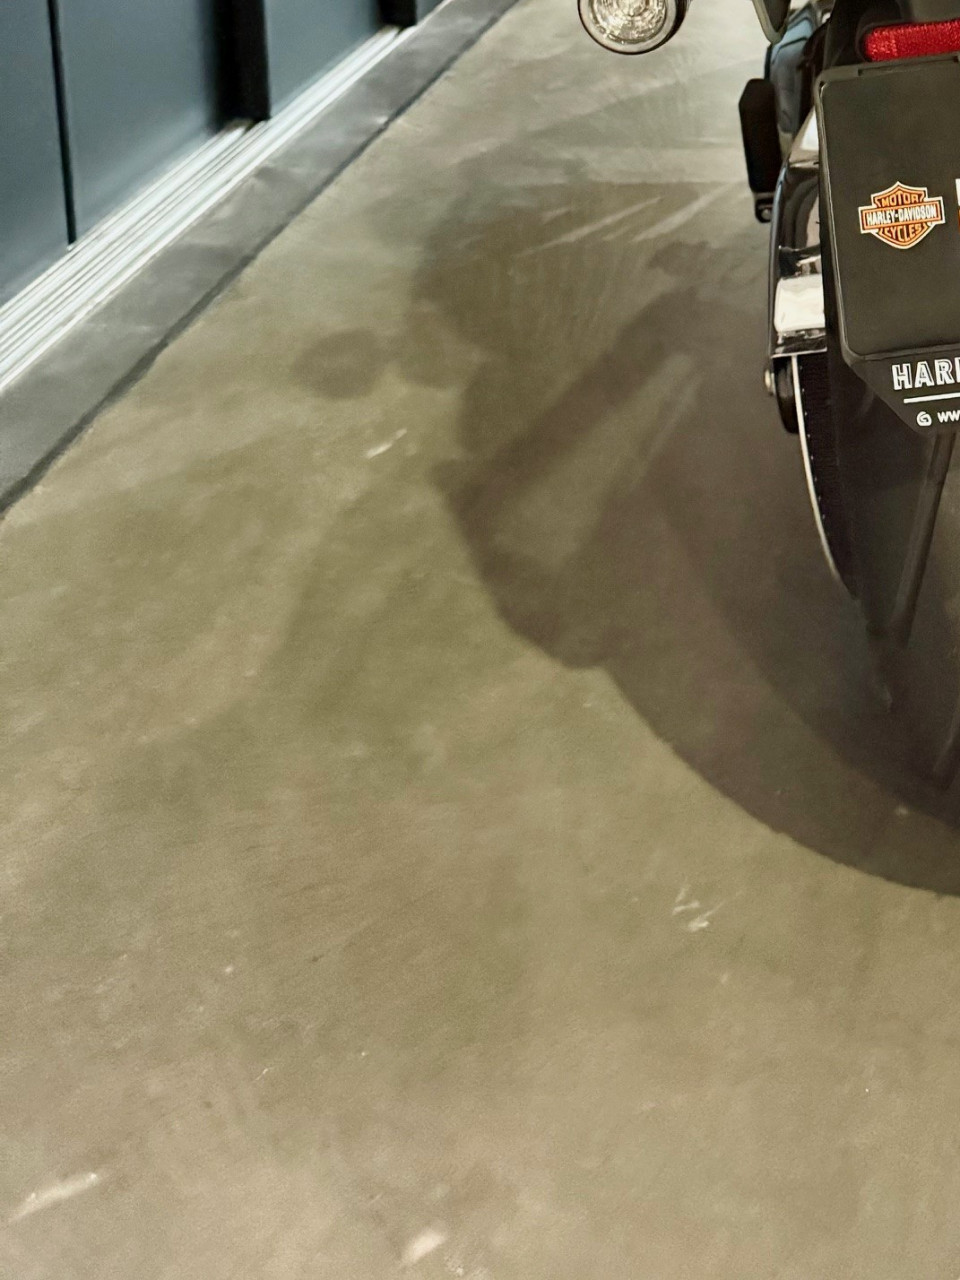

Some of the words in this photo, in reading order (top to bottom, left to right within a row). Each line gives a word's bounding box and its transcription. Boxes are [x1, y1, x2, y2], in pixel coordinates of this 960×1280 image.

[881, 191, 920, 208] MOTOR
[866, 204, 937, 227] HARLEY-DAVIDSON
[883, 223, 922, 242] CYCLES
